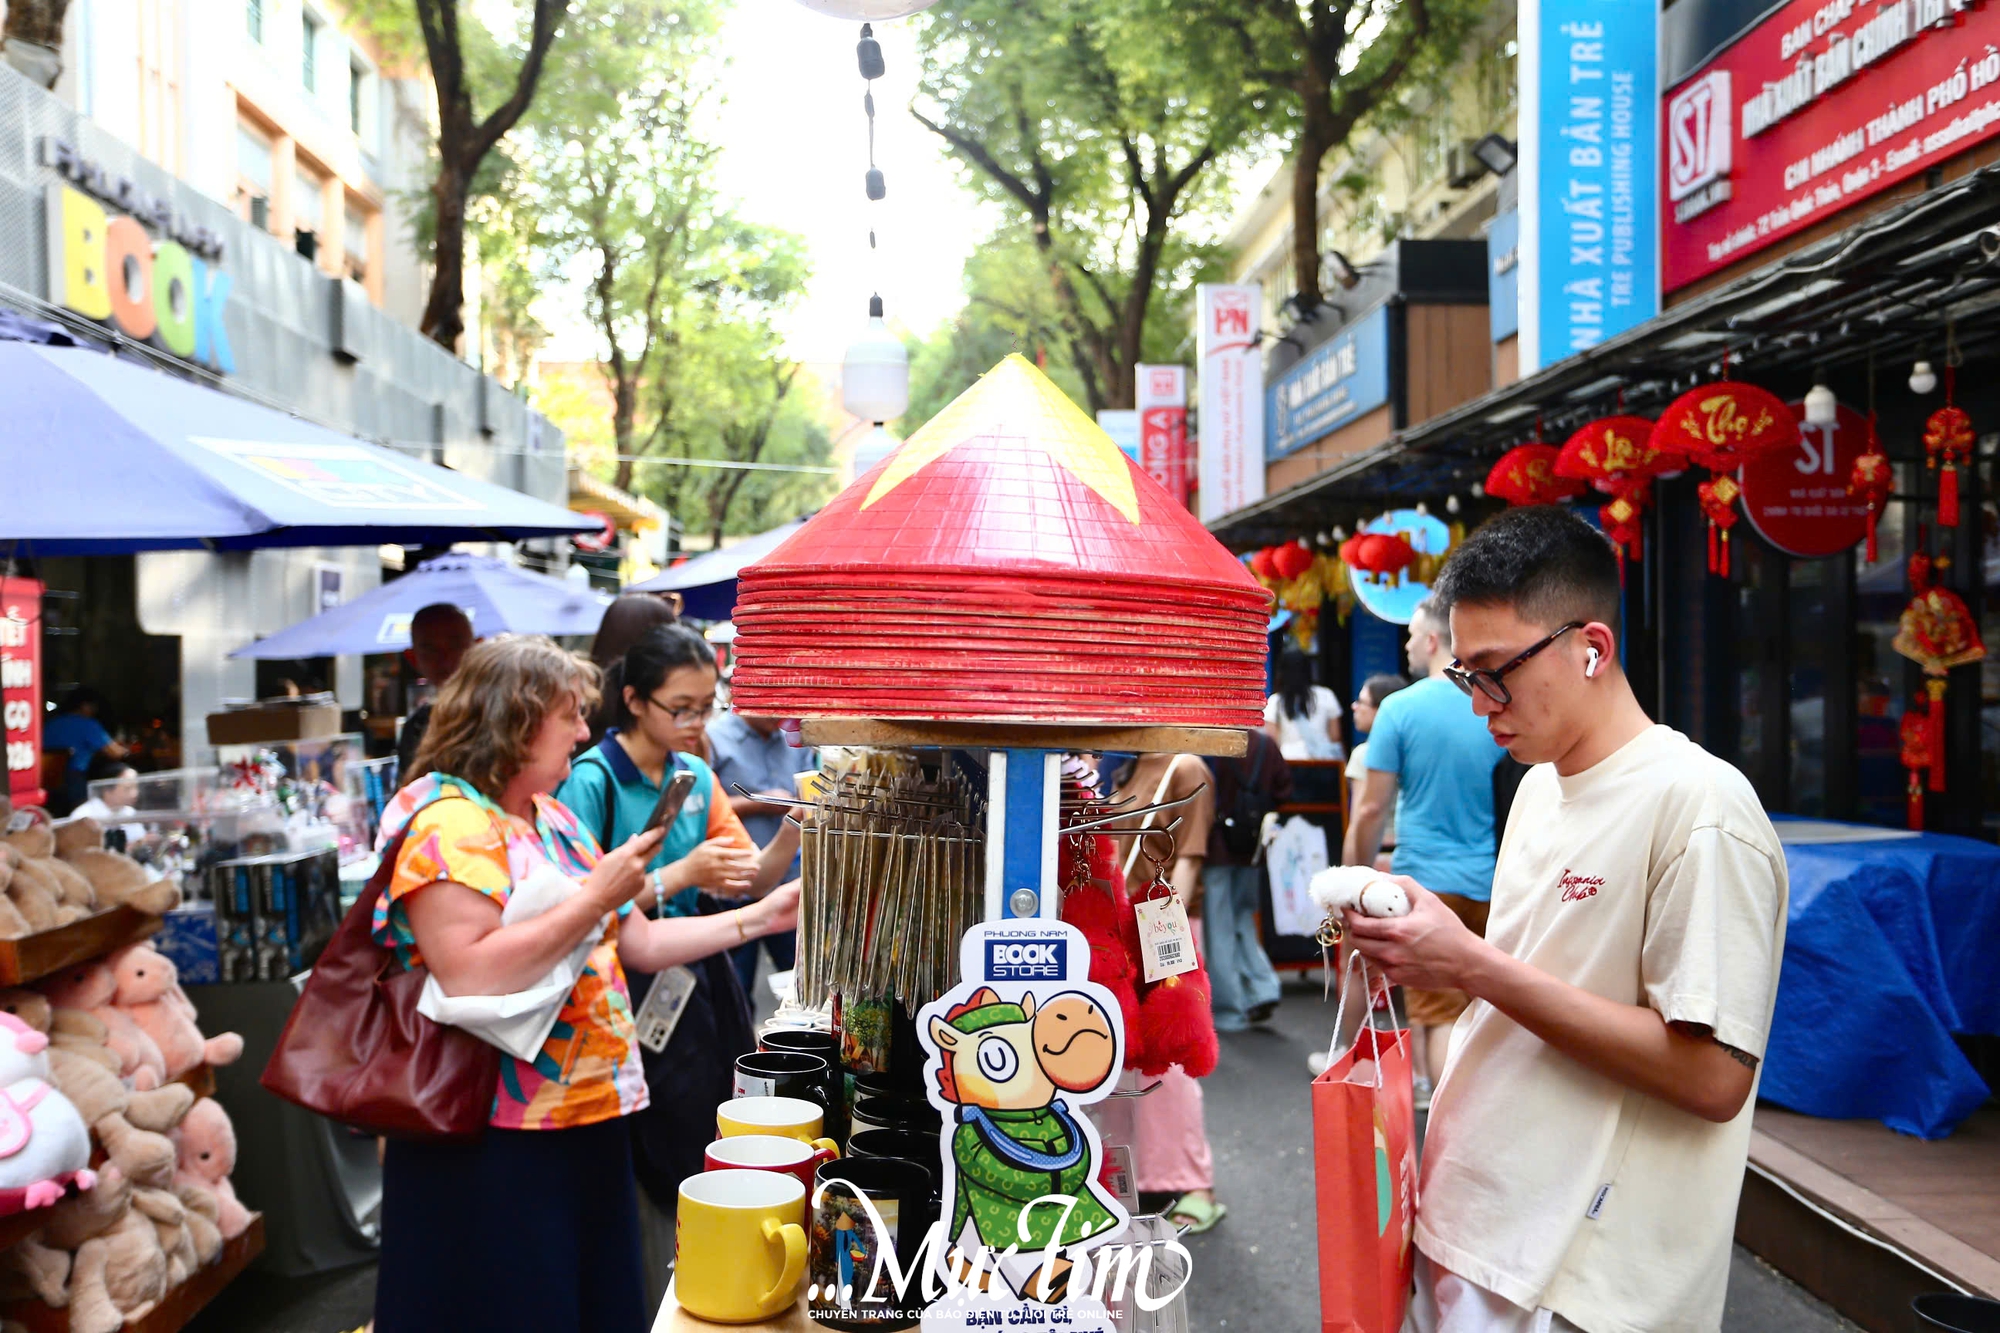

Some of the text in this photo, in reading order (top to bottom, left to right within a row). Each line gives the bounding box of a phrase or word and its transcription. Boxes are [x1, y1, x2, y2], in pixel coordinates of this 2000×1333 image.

[1781, 18, 1812, 60] BAN
[1611, 71, 1633, 139] HOUSE
[1672, 80, 1713, 187] ST
[1784, 157, 1810, 190] CHI
[1865, 101, 1925, 146] THÀNH
[1926, 56, 1968, 115] PHỐ
[1970, 44, 2000, 91] HỒ
[1559, 19, 1604, 350] NHÀ XUẤT BẢN TRẺ
[1611, 142, 1633, 266] PUBLISHING
[50, 184, 237, 374] BOOK
[1214, 308, 1250, 337] PN
[1793, 421, 1841, 475] ST
[993, 943, 1058, 965] BOOK
[993, 965, 1059, 977] STORE
